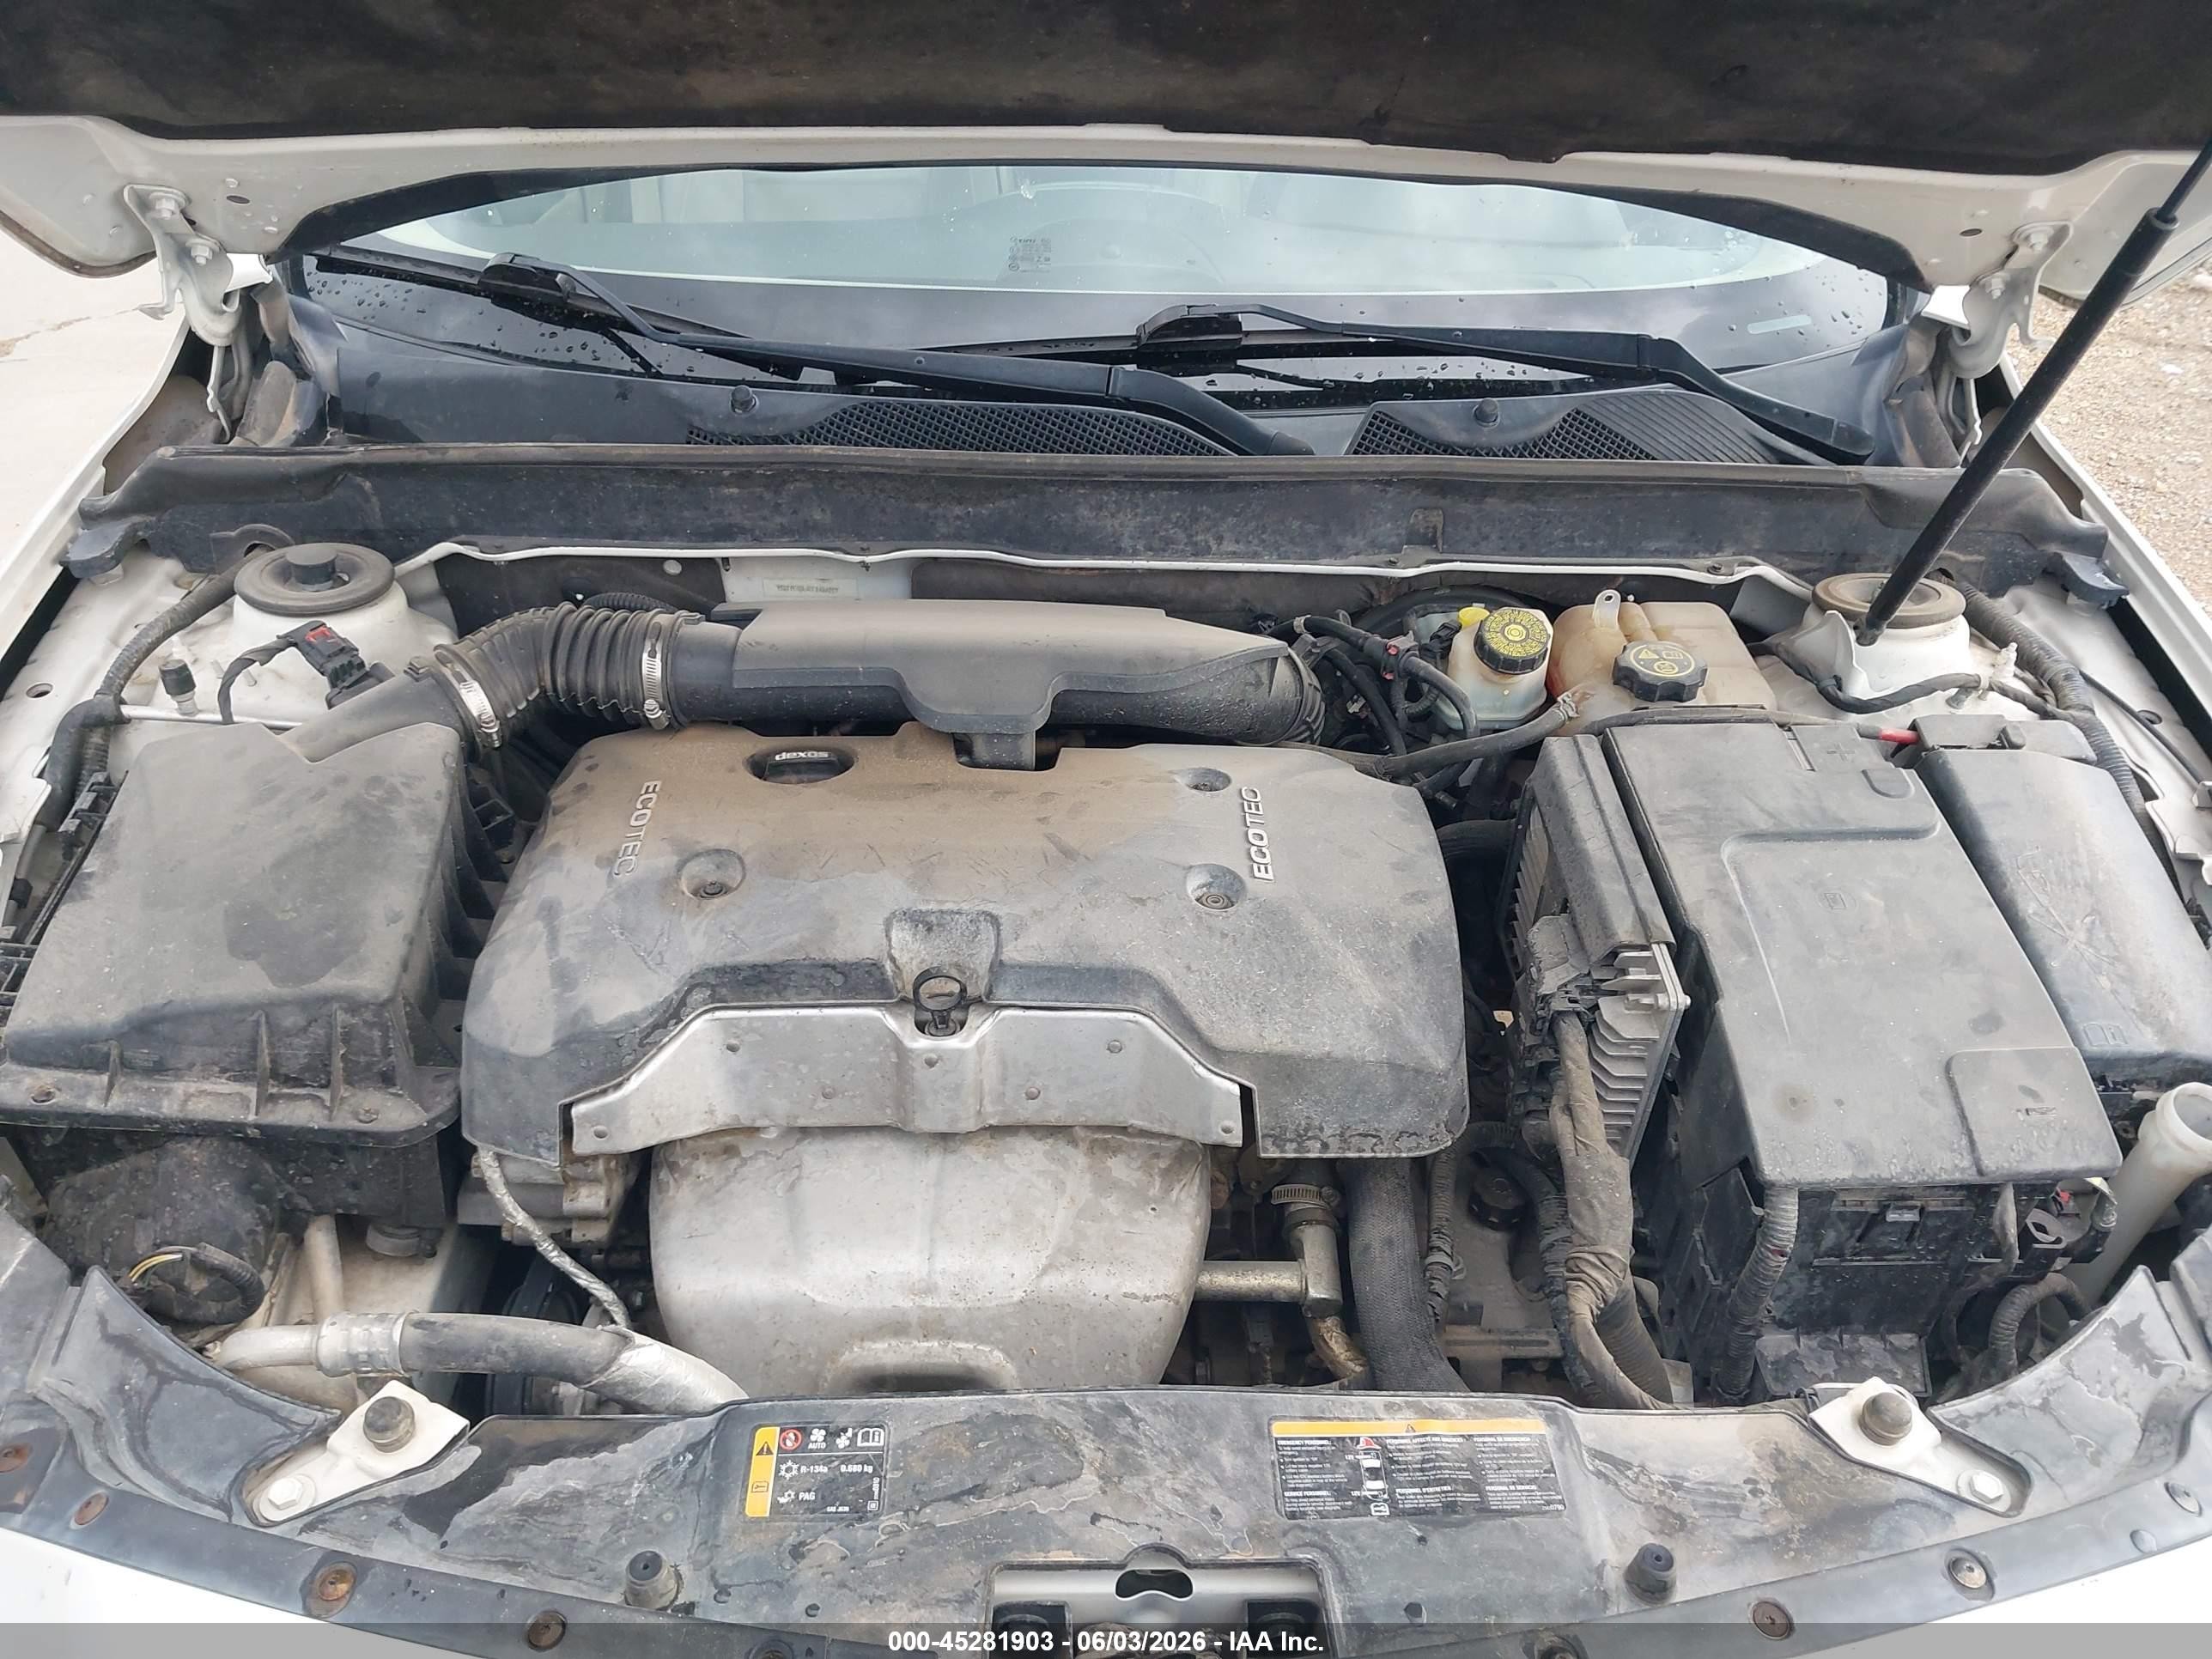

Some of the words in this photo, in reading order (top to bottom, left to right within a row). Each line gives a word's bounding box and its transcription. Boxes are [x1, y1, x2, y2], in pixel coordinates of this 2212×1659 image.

[775, 750, 830, 761] dexos
[614, 780, 662, 877] ECOTEC
[1241, 787, 1274, 882] ECOTEC
[800, 1465, 829, 1474] R-134a
[863, 1464, 874, 1474] kg
[799, 1492, 816, 1501] PAG
